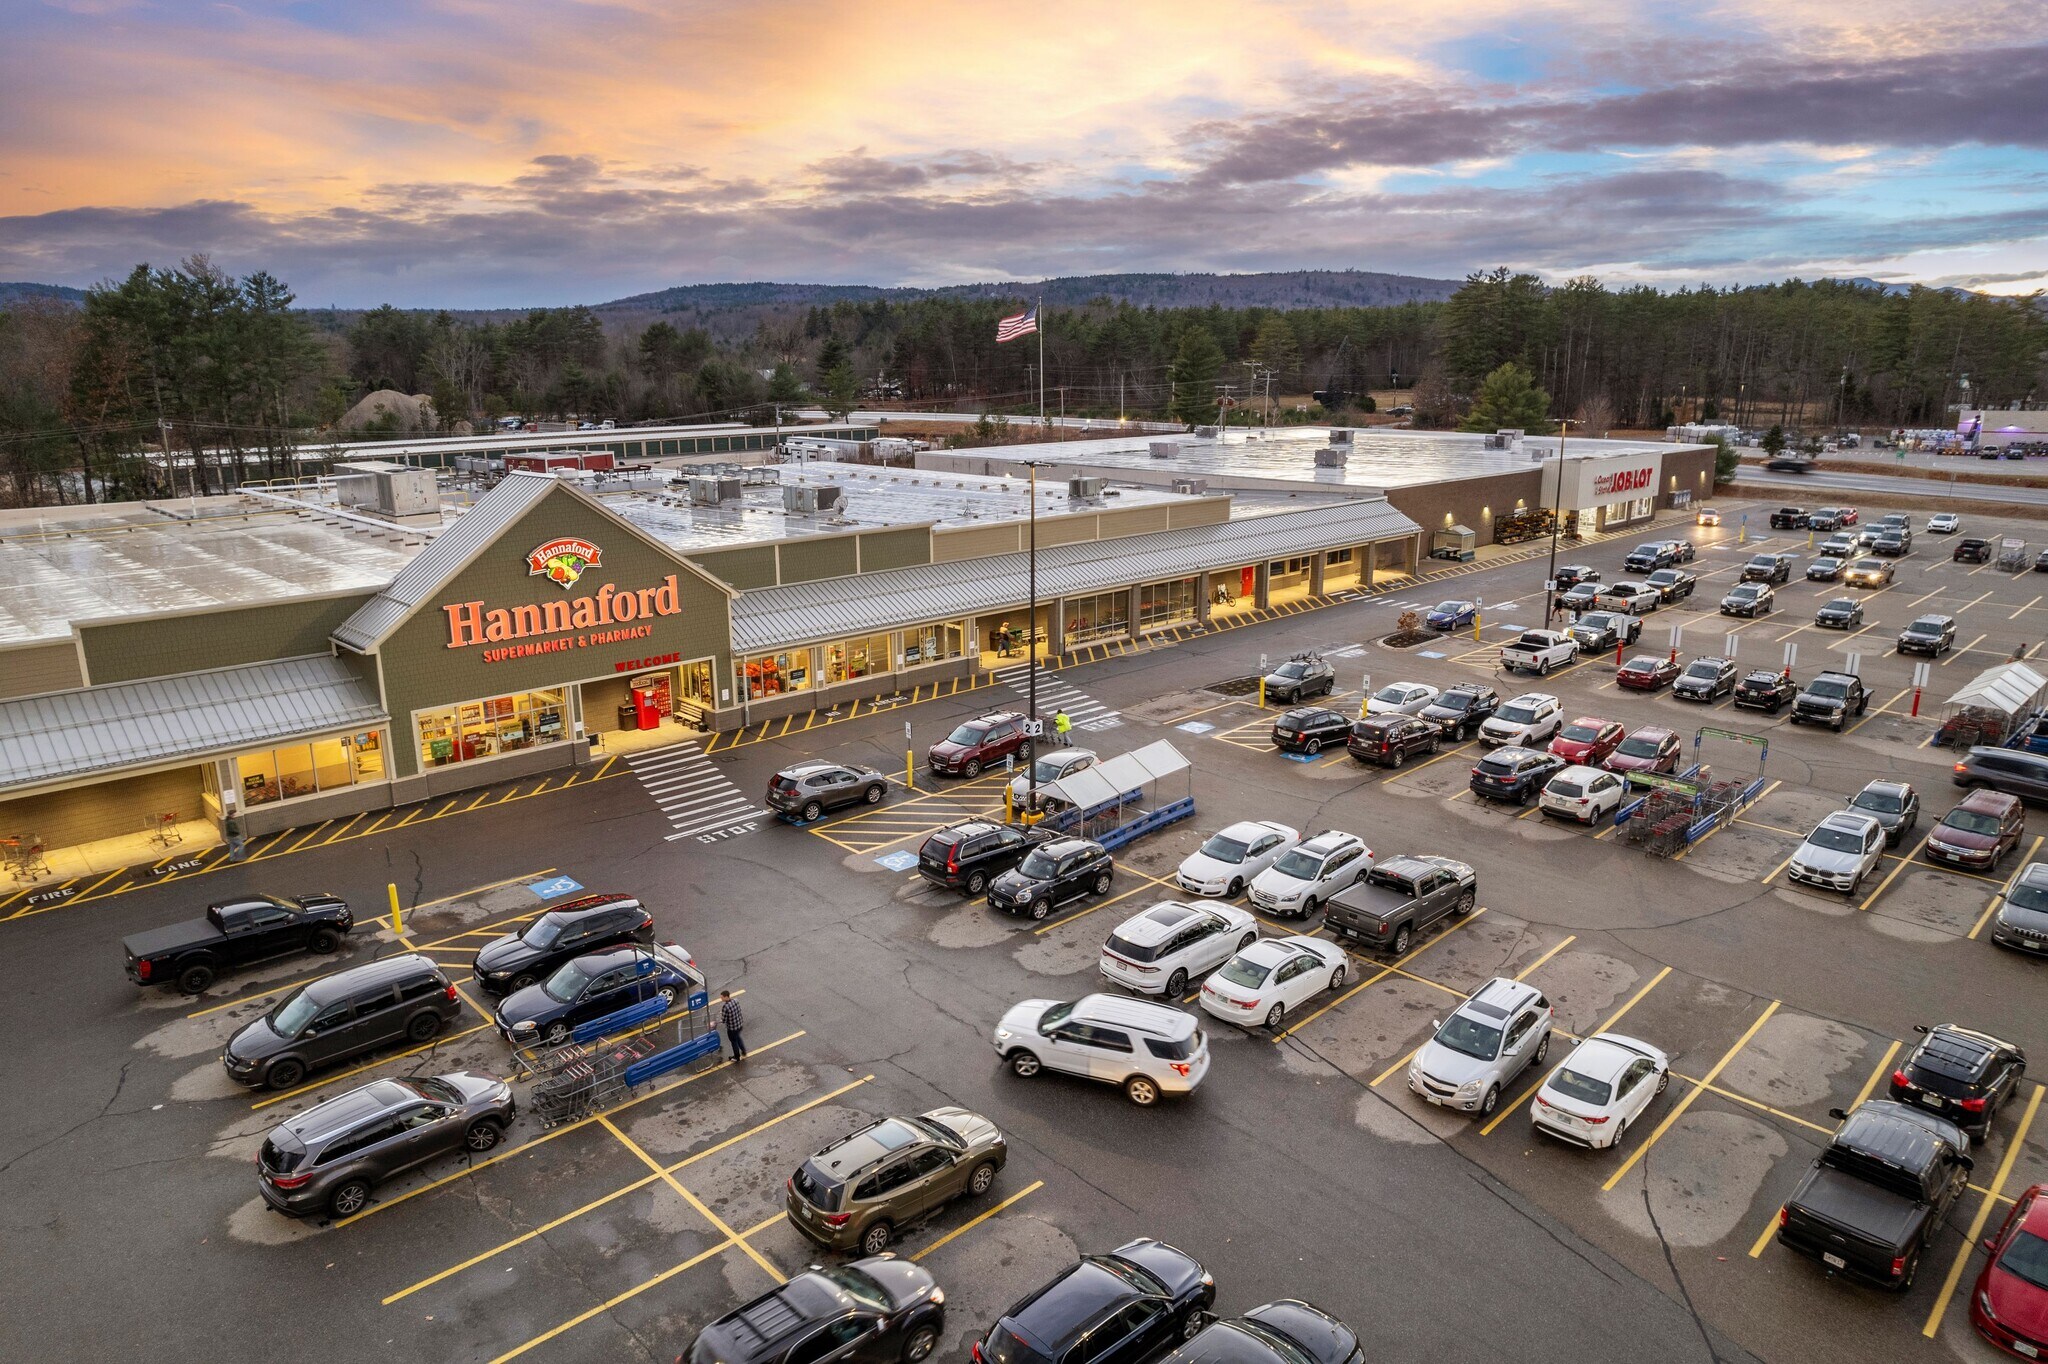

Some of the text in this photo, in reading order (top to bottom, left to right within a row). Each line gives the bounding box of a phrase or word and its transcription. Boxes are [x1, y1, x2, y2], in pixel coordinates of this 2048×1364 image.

[1611, 468, 1653, 493] JOB LOT
[536, 542, 594, 564] Hannaford
[443, 574, 682, 648] Hannaford
[483, 625, 653, 663] SUPERMARKET & PHARMACY
[614, 652, 681, 672] WELCOME
[1025, 723, 1031, 734] 2
[1034, 723, 1041, 734] 2
[153, 859, 202, 875] LANE
[27, 888, 76, 904] FIRE
